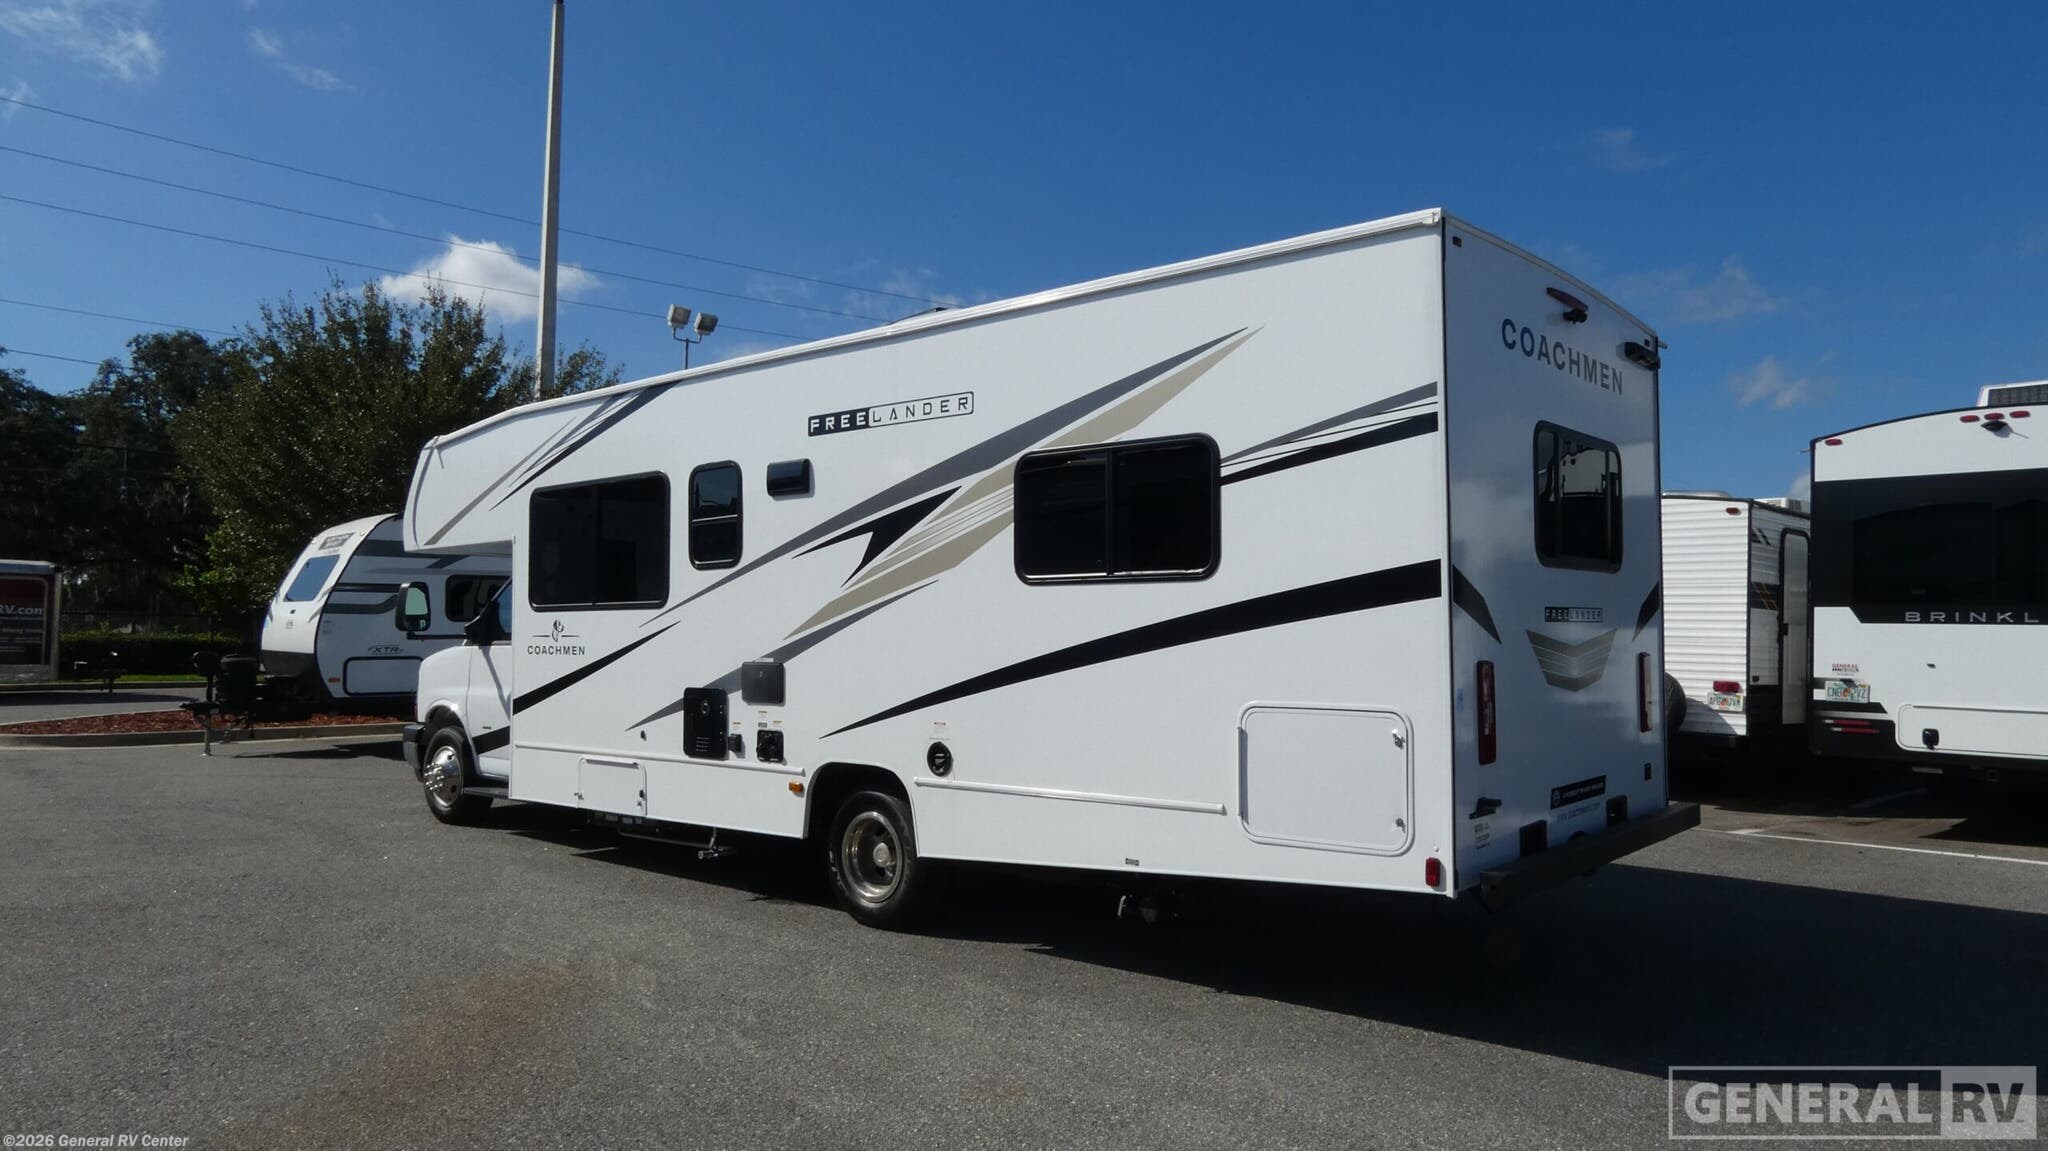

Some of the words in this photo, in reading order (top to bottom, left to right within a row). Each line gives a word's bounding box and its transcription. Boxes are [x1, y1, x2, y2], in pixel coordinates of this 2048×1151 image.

[1501, 318, 1623, 396] COACHMEN
[810, 396, 970, 433] FREELANDER
[1904, 611, 2040, 623] BRINKL
[527, 645, 586, 656] COACHMEN
